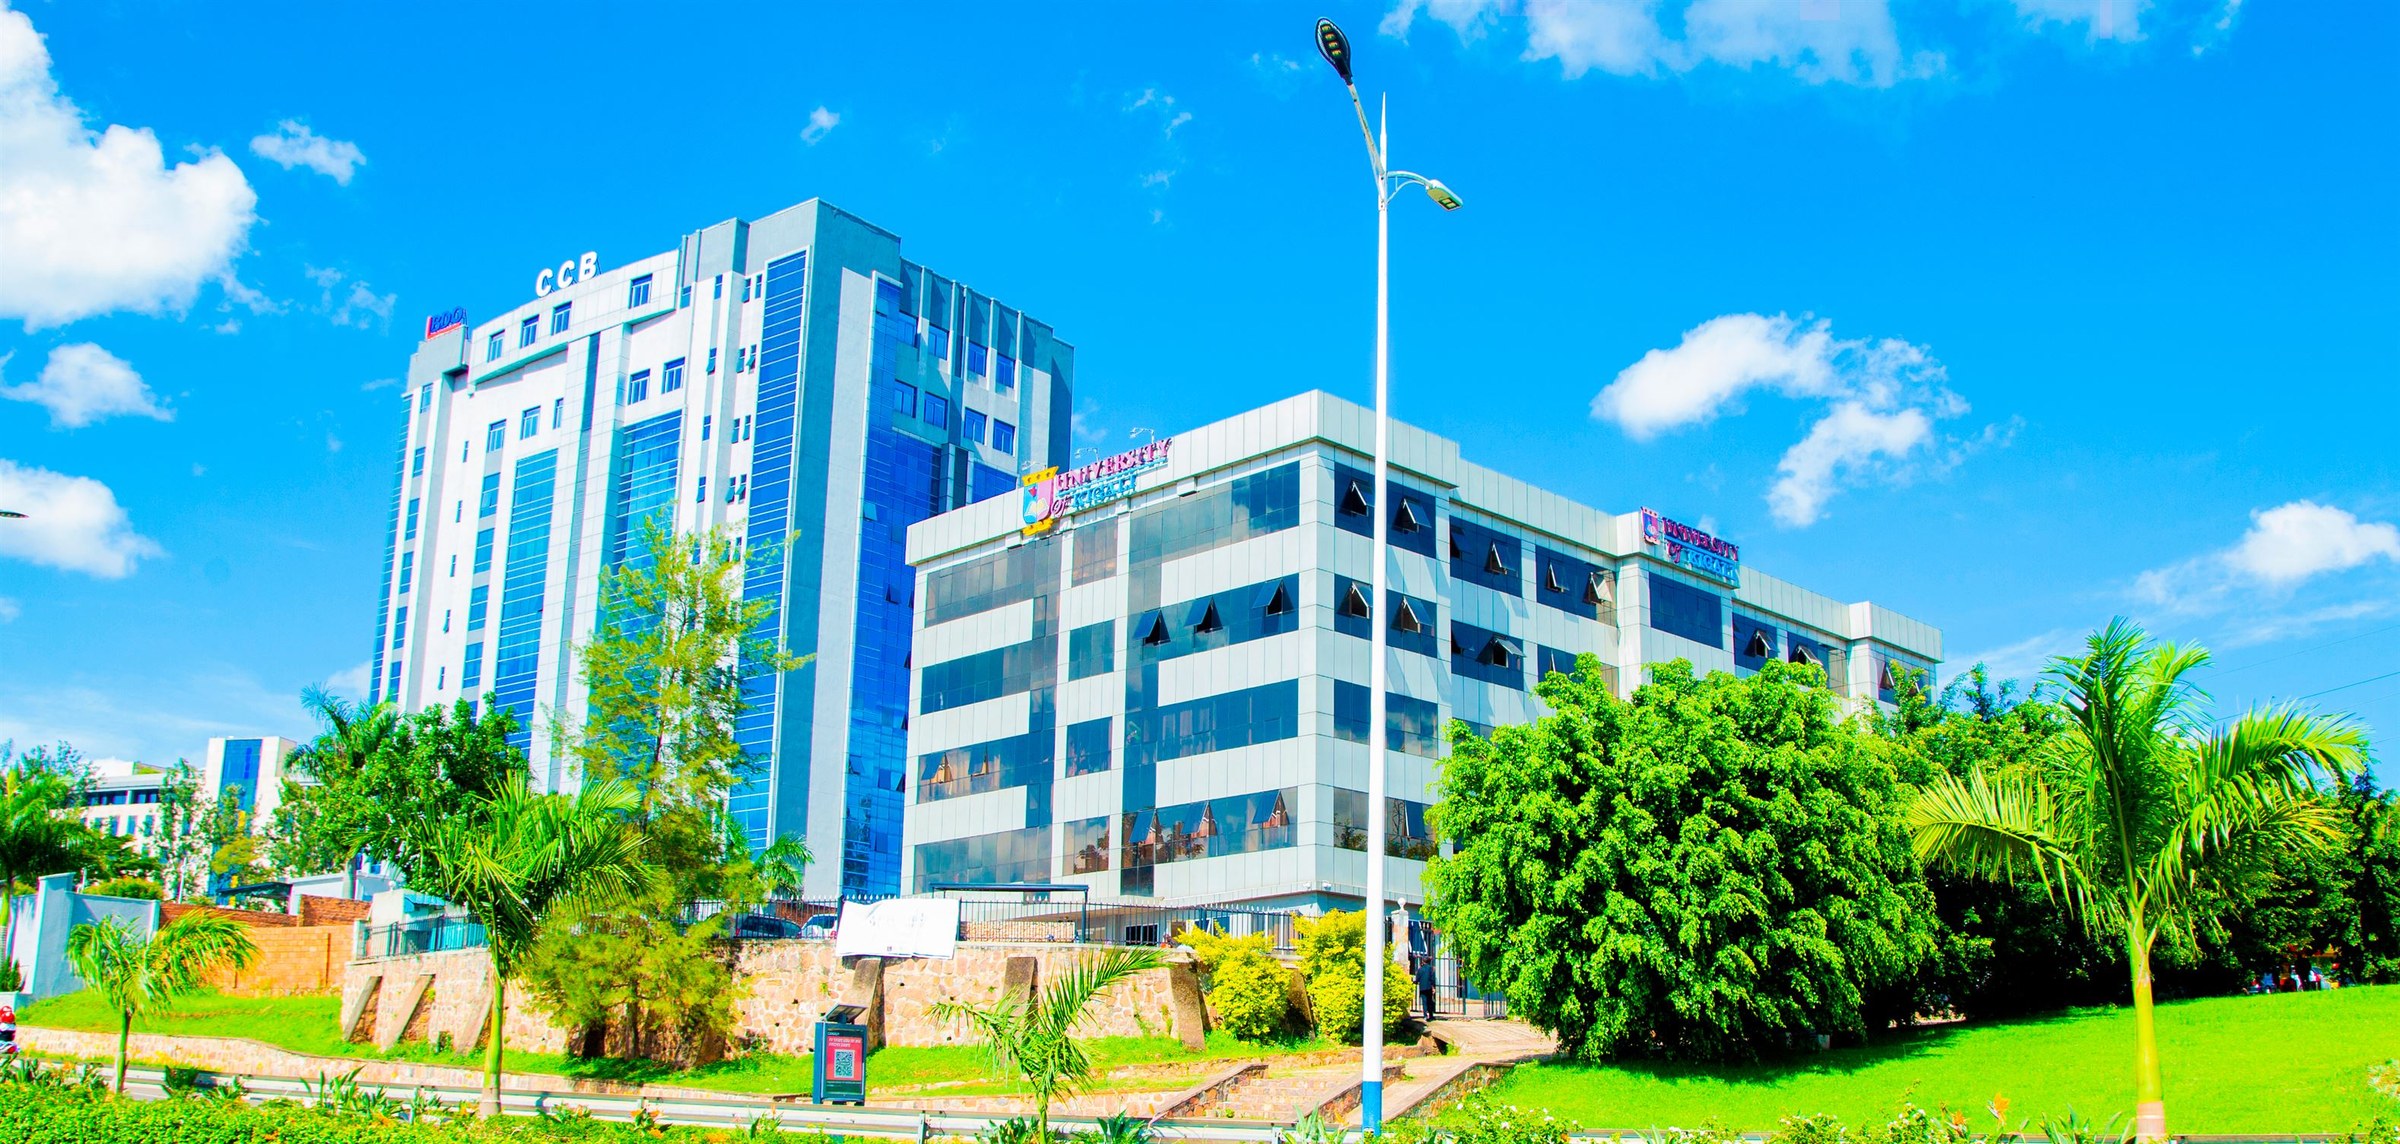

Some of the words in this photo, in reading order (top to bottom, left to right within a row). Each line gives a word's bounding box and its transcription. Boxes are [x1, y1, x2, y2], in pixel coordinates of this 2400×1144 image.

[535, 251, 598, 297] CCB
[430, 306, 464, 333] BDO
[1056, 437, 1173, 491] UNIVERSITY
[1073, 474, 1137, 508] KIGALI
[1662, 516, 1740, 562] UNIVERSITY
[1685, 549, 1738, 582] KIGALI
